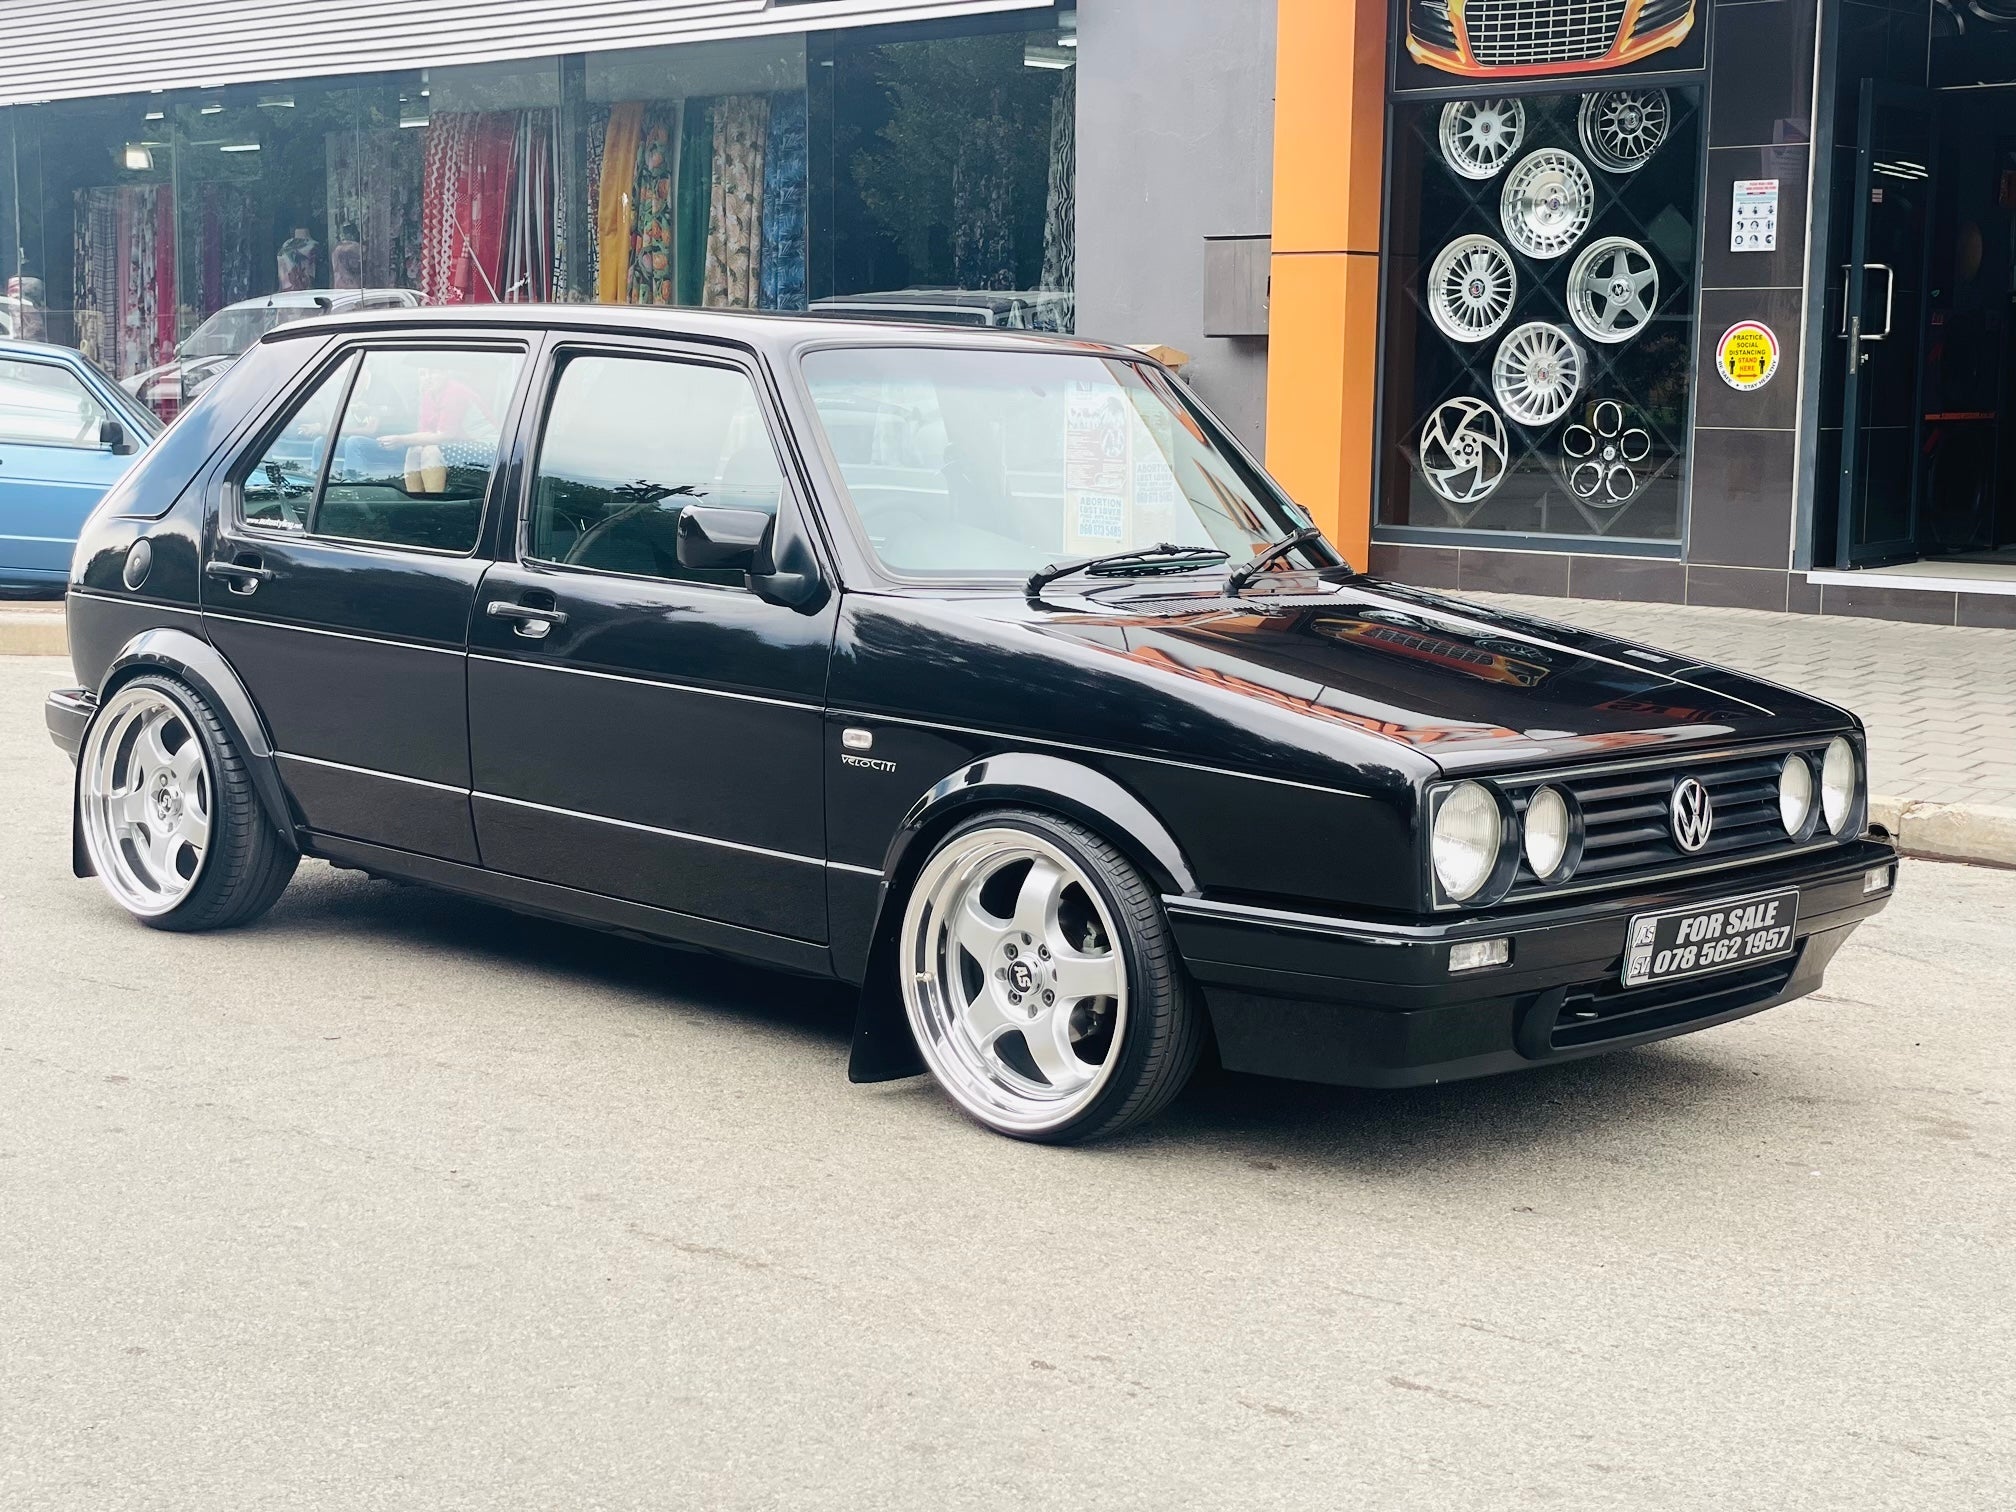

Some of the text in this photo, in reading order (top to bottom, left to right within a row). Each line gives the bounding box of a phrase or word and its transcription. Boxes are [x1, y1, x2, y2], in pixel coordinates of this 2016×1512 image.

[1721, 370, 1733, 384] SAFE
[1758, 360, 1777, 385] HEALTHY
[1080, 496, 1122, 507] ABORTION
[1676, 901, 1780, 945] FOR SALE
[1653, 925, 1791, 974] 078 562 1957
